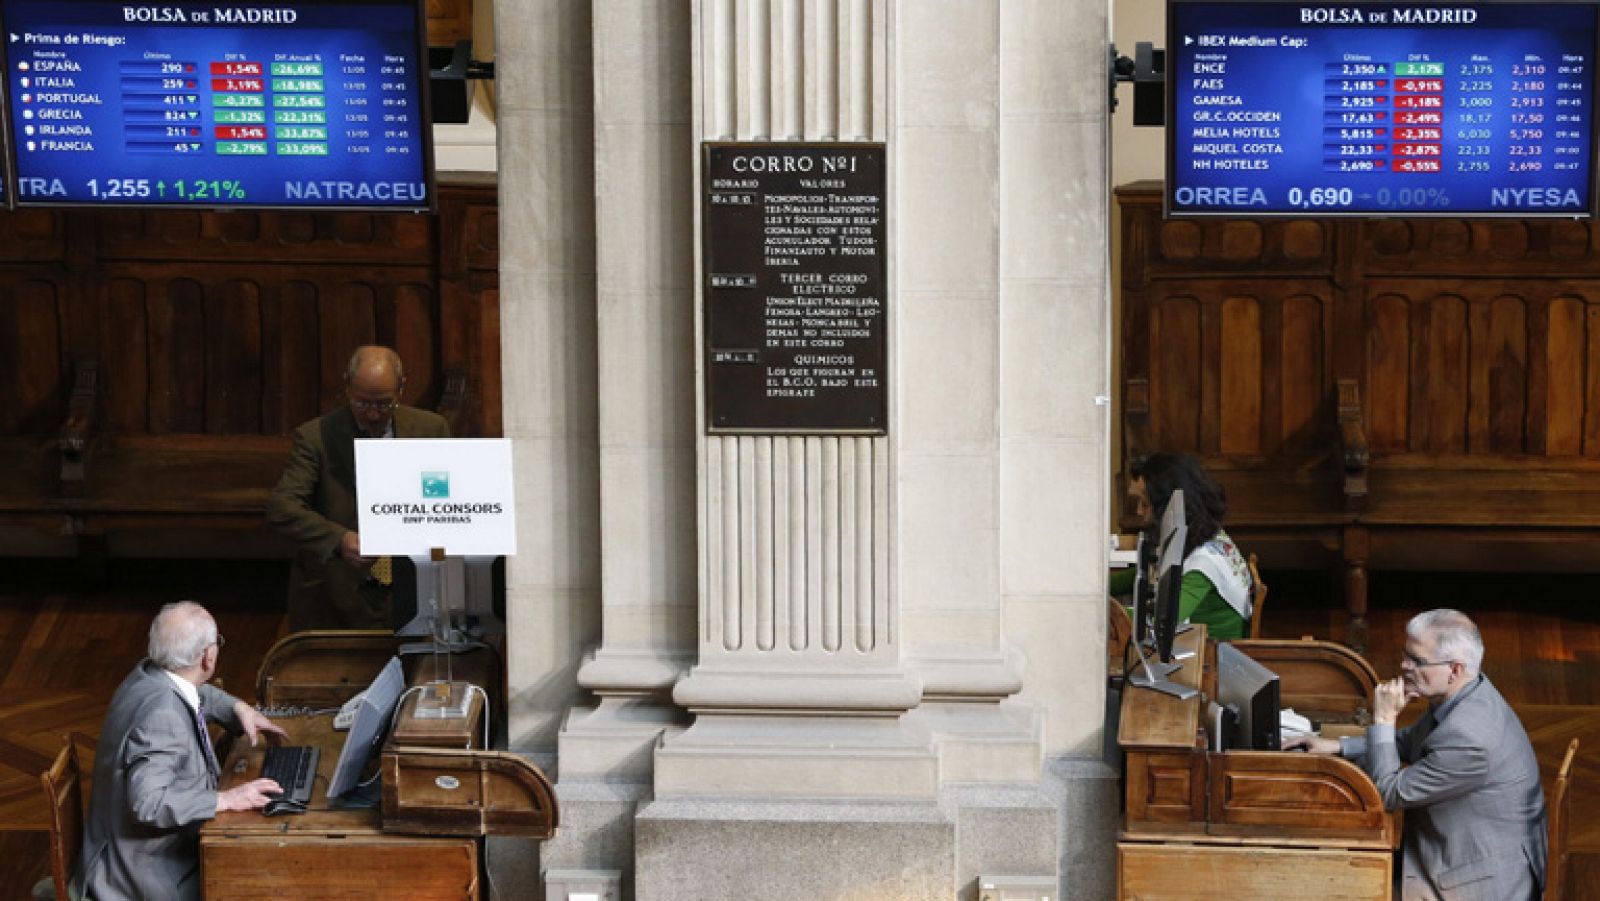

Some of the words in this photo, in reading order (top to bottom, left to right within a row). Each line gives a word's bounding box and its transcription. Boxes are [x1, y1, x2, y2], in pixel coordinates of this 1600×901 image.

[124, 7, 186, 22] BOLSA
[192, 12, 209, 22] DE
[215, 8, 297, 23] MADRID
[1301, 8, 1364, 23] BOLSA
[1369, 13, 1387, 23] DE
[1393, 8, 1477, 24] MADRID
[24, 33, 60, 44] Prima
[65, 33, 79, 44] de
[83, 34, 126, 46] Riesgo:
[1197, 35, 1225, 46] IBEX
[1229, 35, 1277, 46] Medium
[1280, 36, 1308, 48] Cap:
[33, 59, 81, 72] ESPAÑA
[1194, 62, 1225, 73] ENCE
[35, 77, 75, 88] ITALIA
[1194, 79, 1223, 90] FAES
[37, 94, 102, 104] PORTUGAL
[1194, 96, 1242, 105] GAMESA
[38, 109, 83, 120] GRECIA
[39, 125, 92, 135] IRLANDA
[1193, 128, 1229, 138] MELIA
[1233, 128, 1279, 138] HOTELS
[41, 141, 94, 151] FRANCIA
[1193, 144, 1237, 154] MIQUEL
[1243, 144, 1283, 153] COSTA
[733, 156, 813, 172] CORRO
[1193, 160, 1211, 170] NH
[1214, 160, 1269, 170] HOTELES
[800, 179, 846, 188] VALORES
[18, 178, 67, 196] TRA
[86, 178, 150, 200] 1,255
[174, 180, 245, 201] 1,21%
[284, 181, 425, 200] NATRACEU
[1175, 187, 1267, 205] ORREA
[1289, 187, 1352, 208] 0,690
[1377, 188, 1449, 208] 0,00%
[1491, 188, 1580, 206] NYESA
[780, 273, 822, 283] TERCER
[828, 273, 868, 283] CORRO
[794, 355, 854, 365] QUIMICOS
[767, 367, 786, 376] LOS
[371, 503, 429, 515] CORTAL
[432, 502, 502, 514] CONSORS
[403, 516, 425, 524] BNP
[427, 516, 471, 524] PARIBAS
